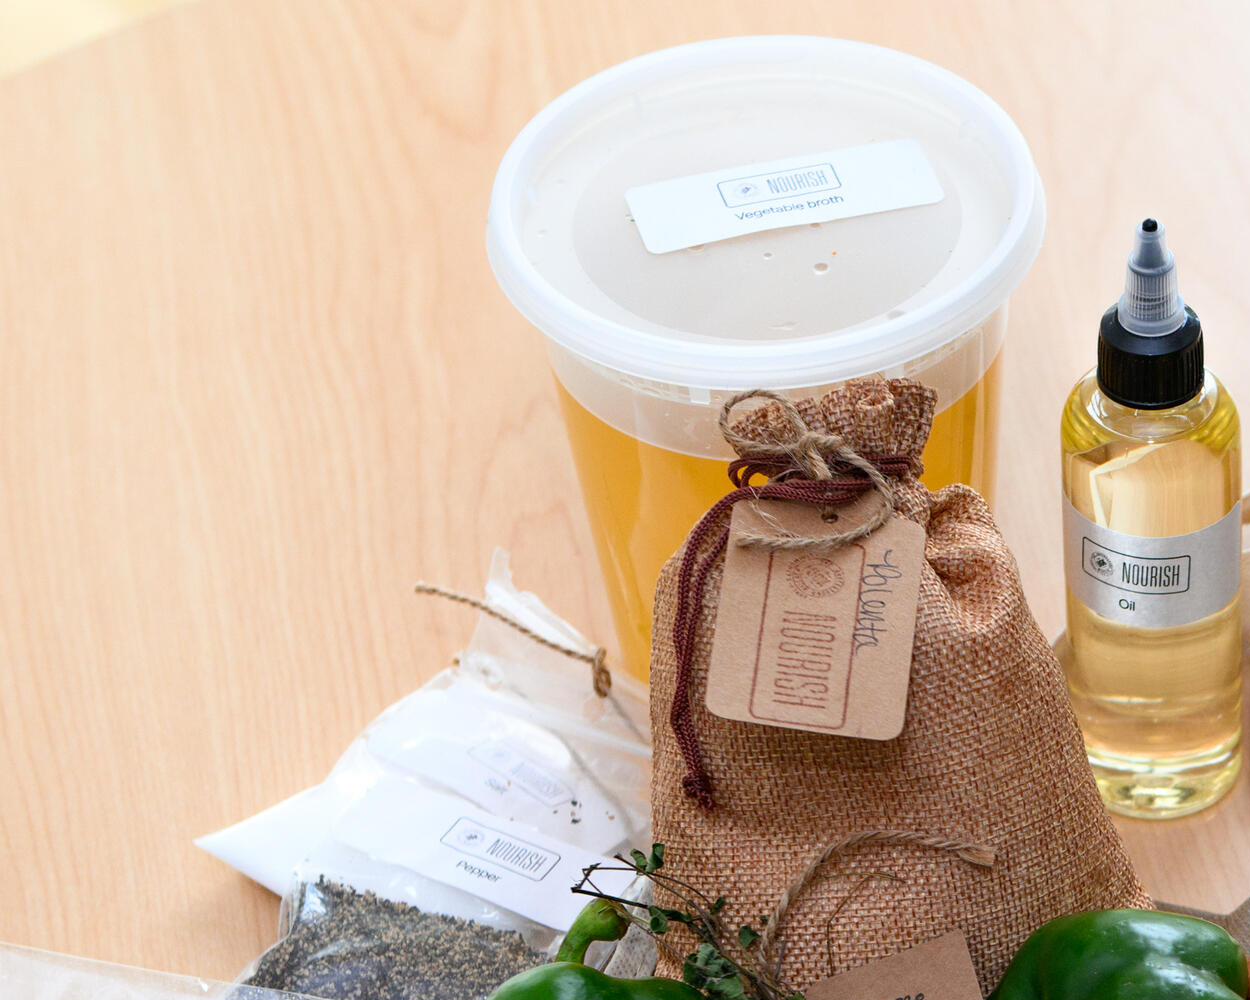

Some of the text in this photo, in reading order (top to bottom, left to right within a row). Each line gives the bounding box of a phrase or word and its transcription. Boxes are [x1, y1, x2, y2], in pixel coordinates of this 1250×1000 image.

[766, 170, 829, 194] NOURISH
[735, 195, 845, 221] Vegetable broth
[1122, 562, 1180, 587] NOURISH
[1119, 598, 1135, 611] Oil
[773, 610, 837, 709] NOURISH
[486, 838, 548, 873] NOURISH
[456, 859, 502, 883] Pepper
